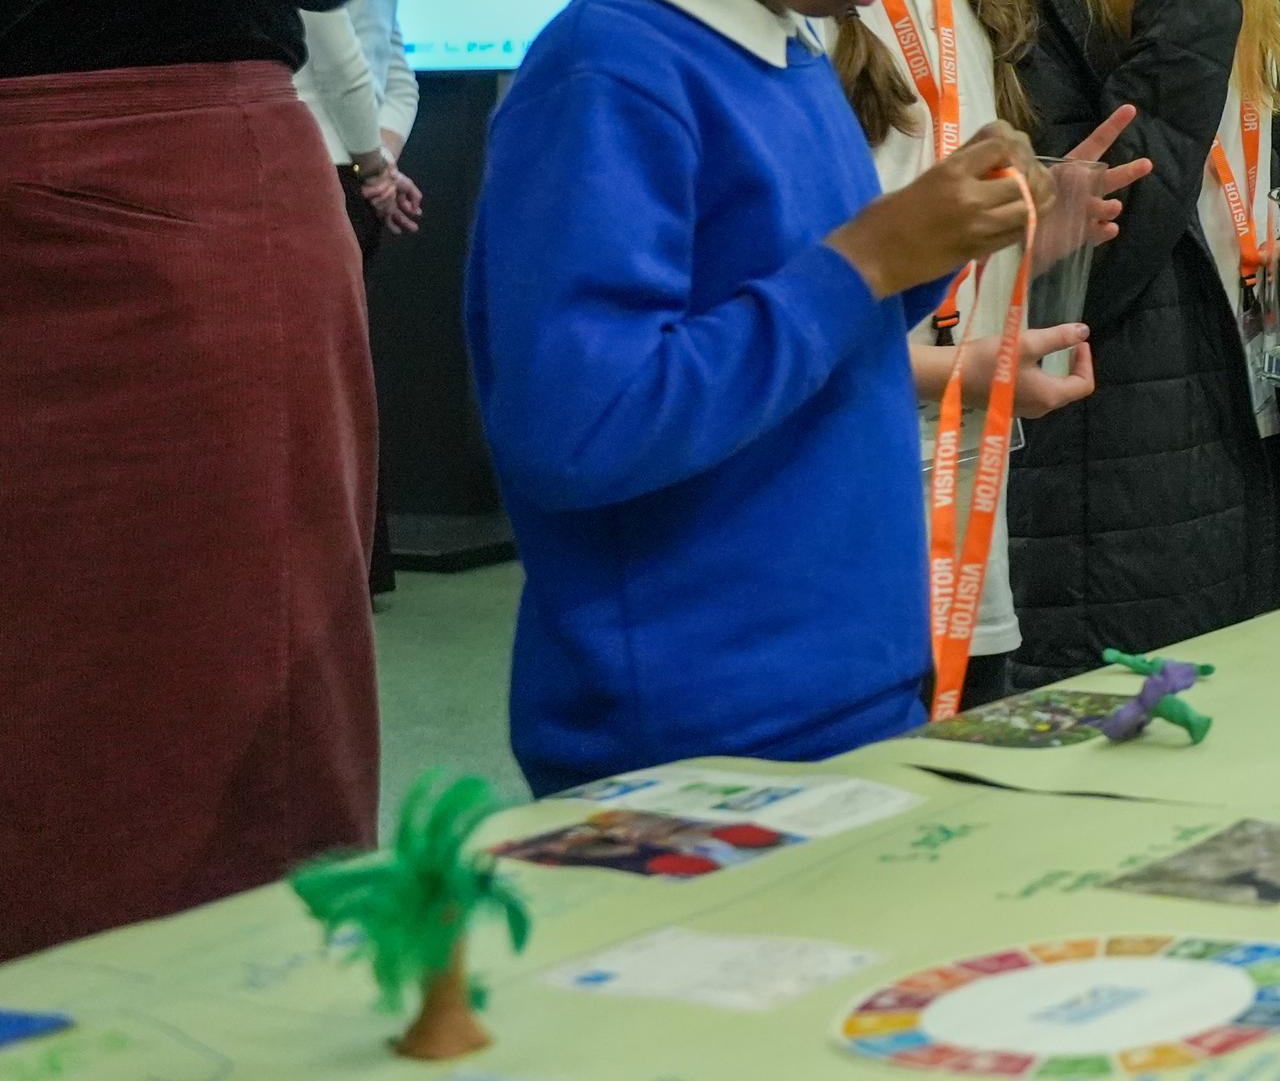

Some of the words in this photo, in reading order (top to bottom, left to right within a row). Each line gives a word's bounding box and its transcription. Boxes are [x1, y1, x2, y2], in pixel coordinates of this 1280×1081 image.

[894, 16, 930, 80] VISITOR
[941, 27, 958, 85] VISITOR
[1224, 181, 1249, 237] VISITOR
[934, 430, 957, 508] VISITOR
[974, 435, 1005, 512] VISITOR
[948, 563, 984, 640] VISITOR
